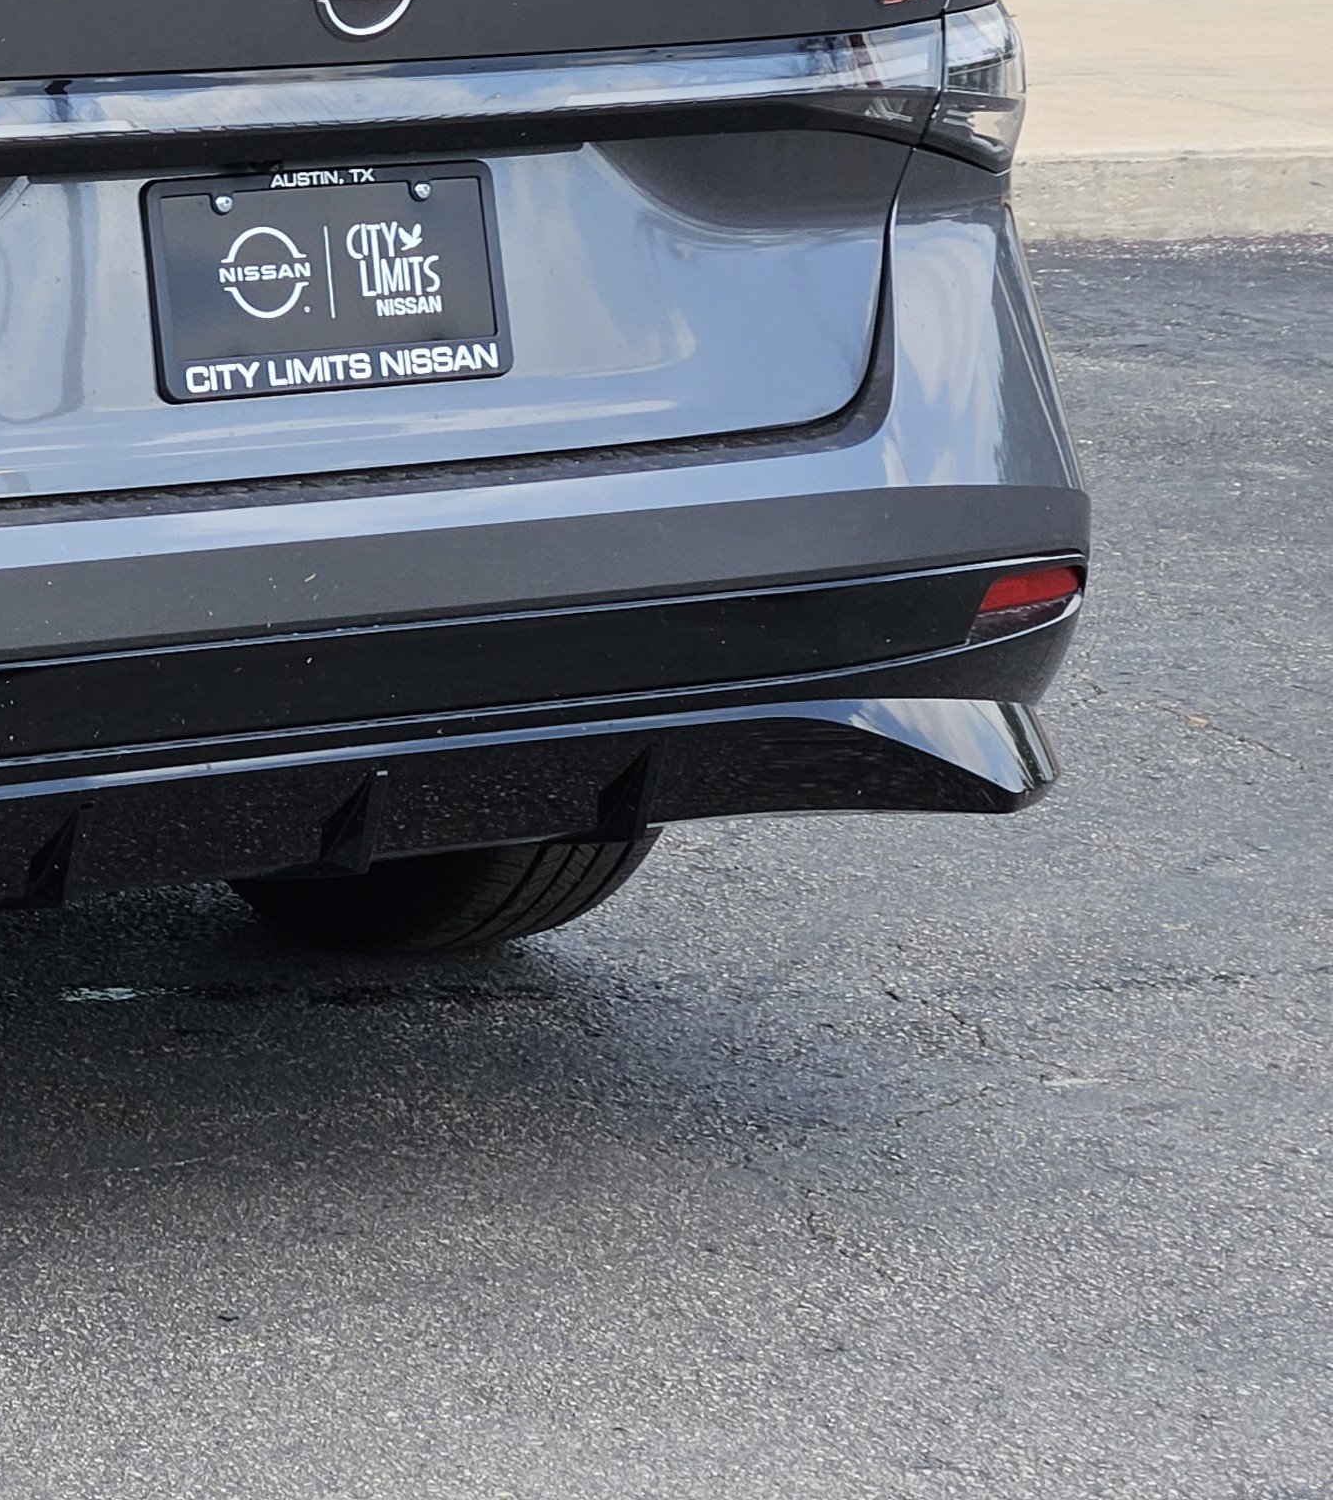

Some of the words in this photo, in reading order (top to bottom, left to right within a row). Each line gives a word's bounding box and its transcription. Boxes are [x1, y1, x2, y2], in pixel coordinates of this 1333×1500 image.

[270, 170, 344, 188] AUSTIN,
[348, 168, 375, 182] TX
[345, 221, 398, 260] CITY
[218, 261, 311, 283] NISSAN
[359, 255, 441, 297] LIMITS
[376, 295, 442, 317] NISSAN
[185, 360, 260, 394] CITY
[267, 352, 372, 388] LIMITS
[380, 342, 498, 377] NISSAN
